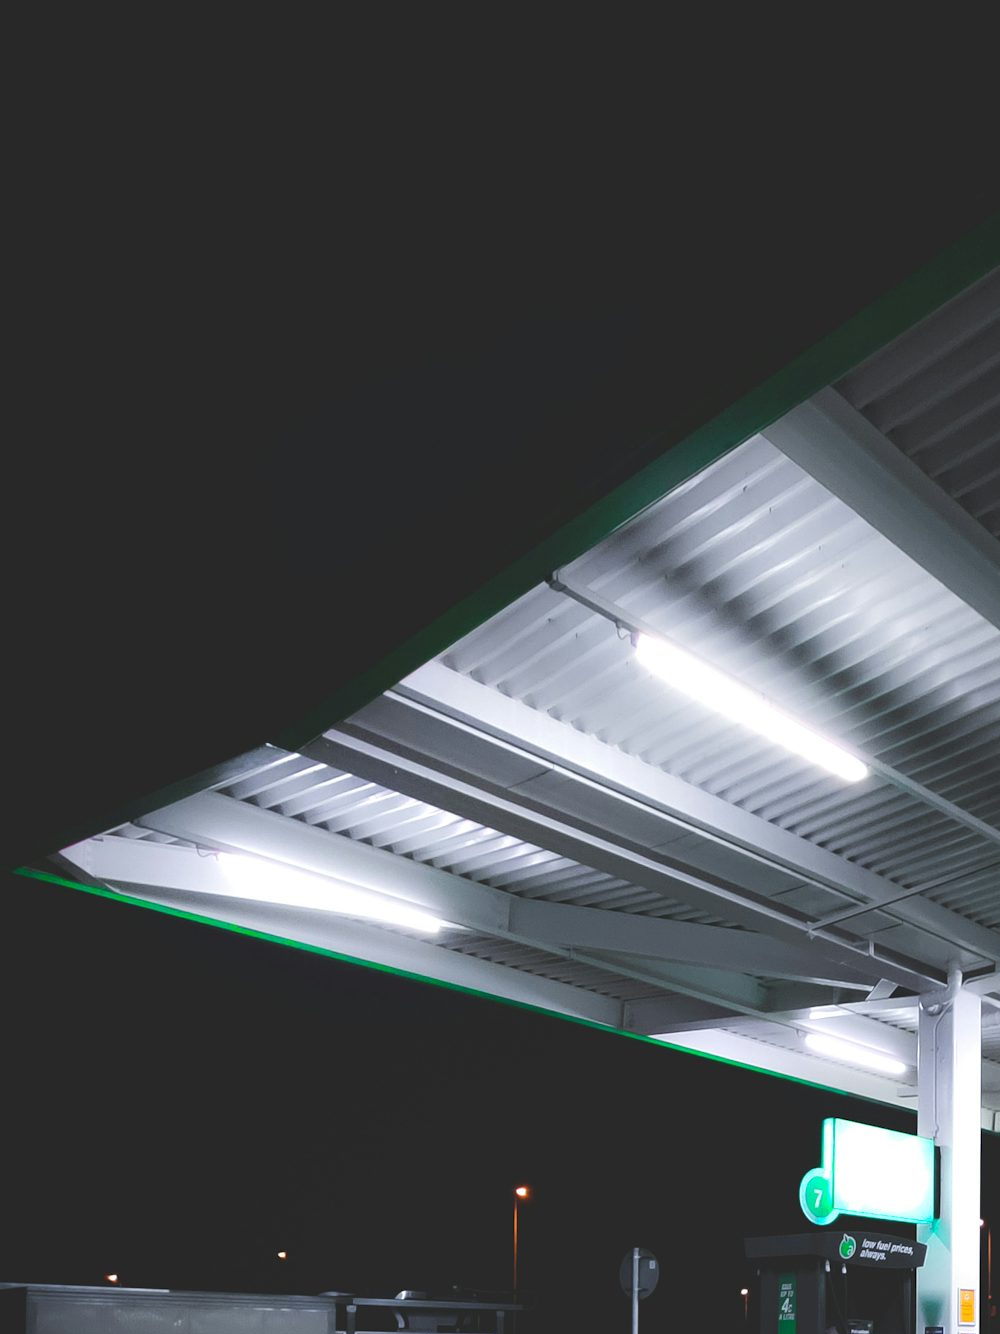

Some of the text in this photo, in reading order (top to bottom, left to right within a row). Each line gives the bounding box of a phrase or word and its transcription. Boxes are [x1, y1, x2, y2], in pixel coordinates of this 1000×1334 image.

[814, 1189, 823, 1209] 7
[860, 1249, 887, 1261] always.
[862, 1238, 914, 1256] low fuel prices,
